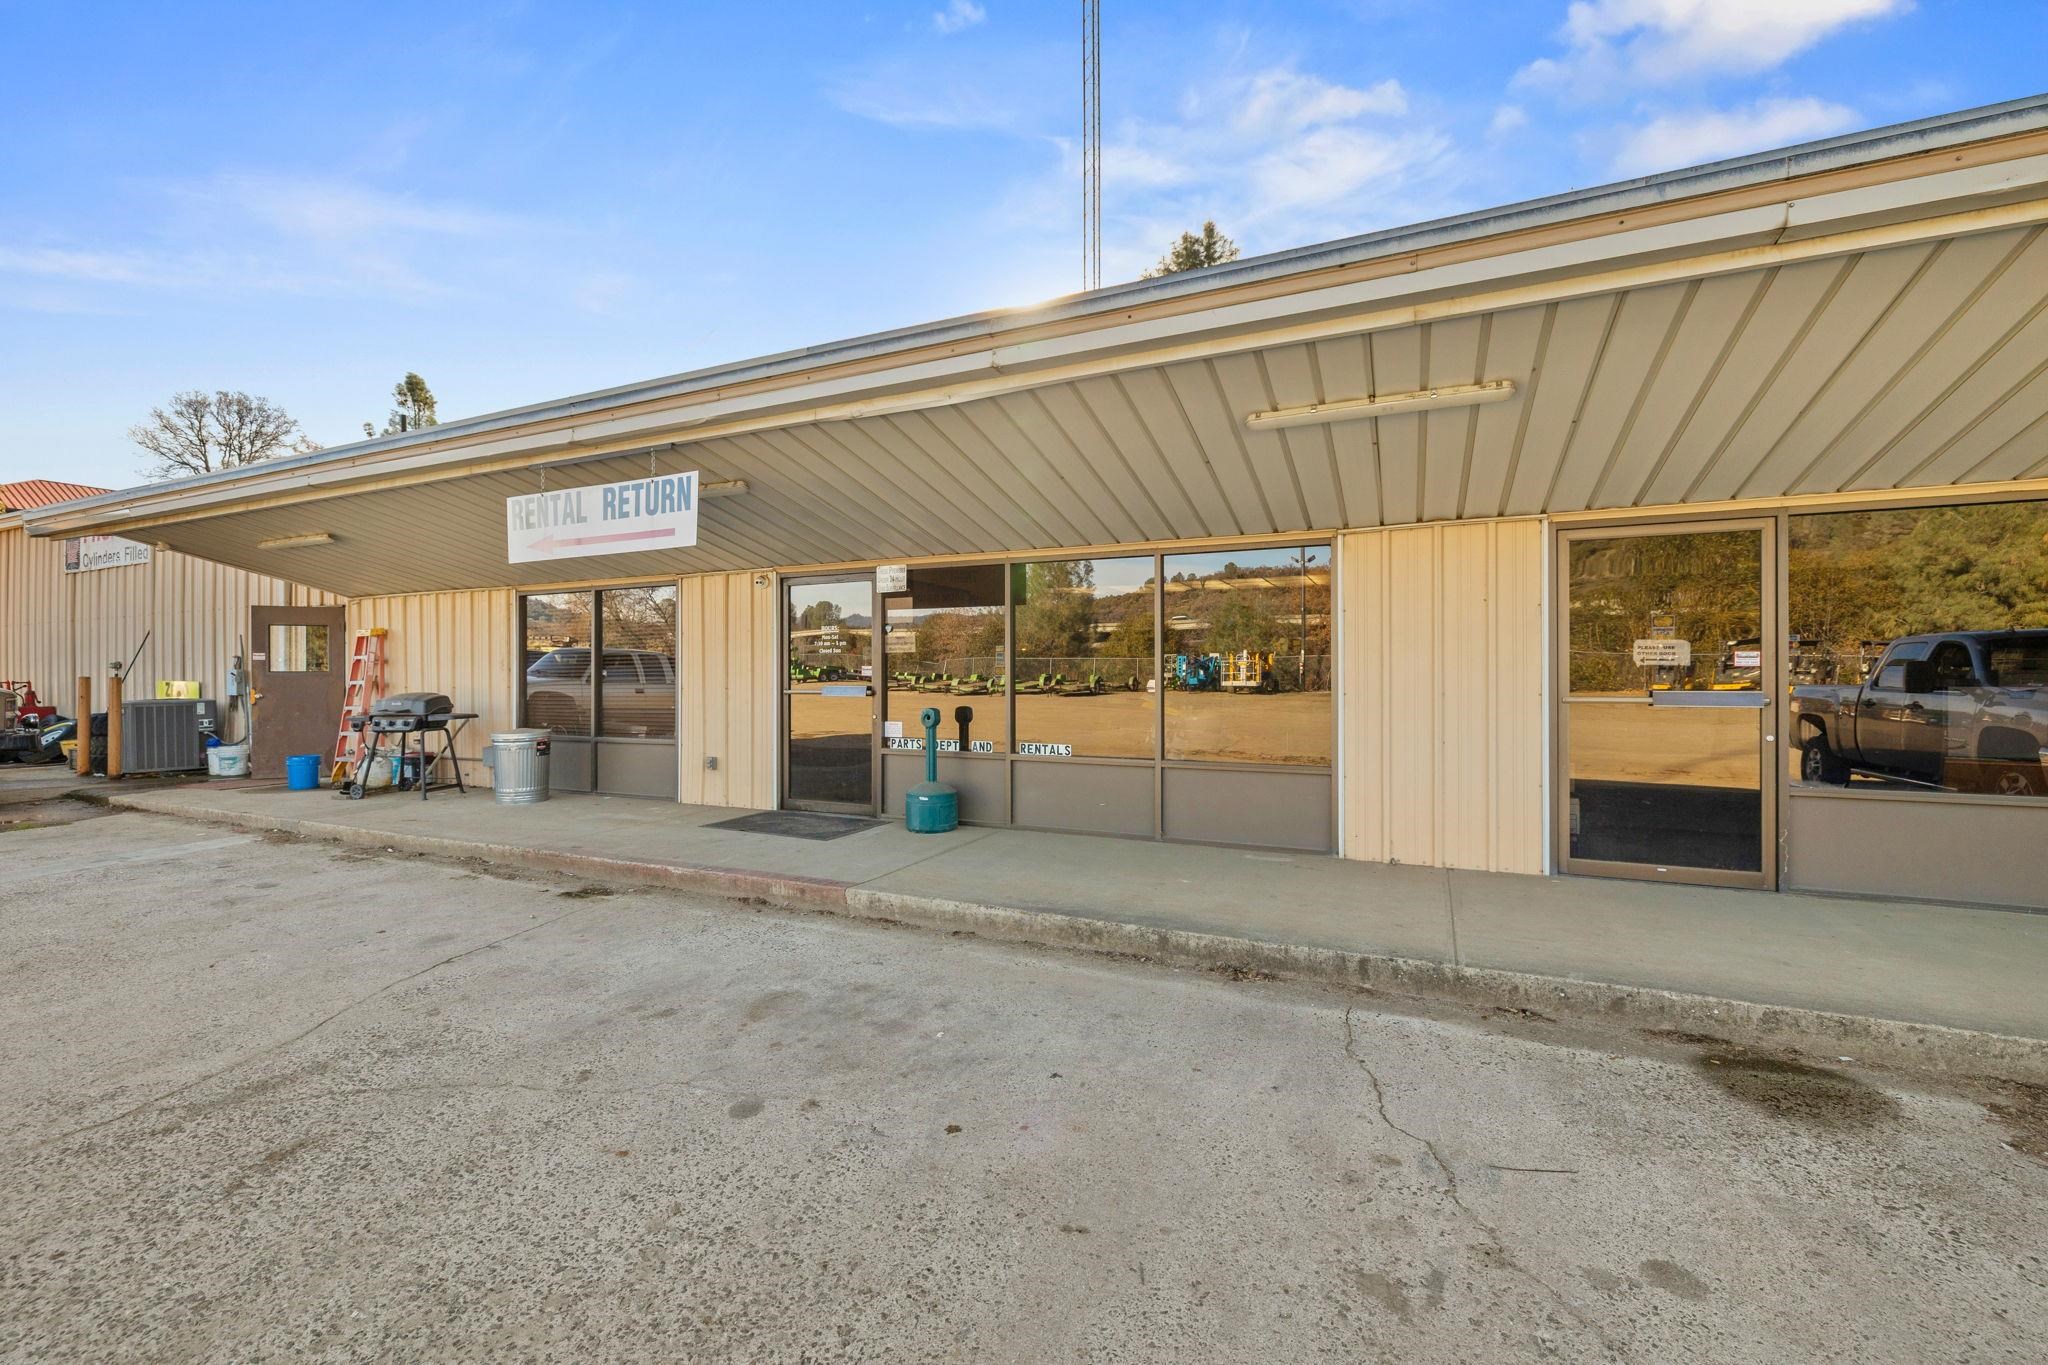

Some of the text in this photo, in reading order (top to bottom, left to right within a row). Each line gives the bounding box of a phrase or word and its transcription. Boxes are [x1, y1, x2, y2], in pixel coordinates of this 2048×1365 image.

[512, 475, 692, 532] RENTAL RETURN
[83, 545, 149, 569] Cylinders Filled
[891, 738, 922, 749] PARTS
[972, 741, 992, 752] AND
[1020, 743, 1071, 756] RENTALS
